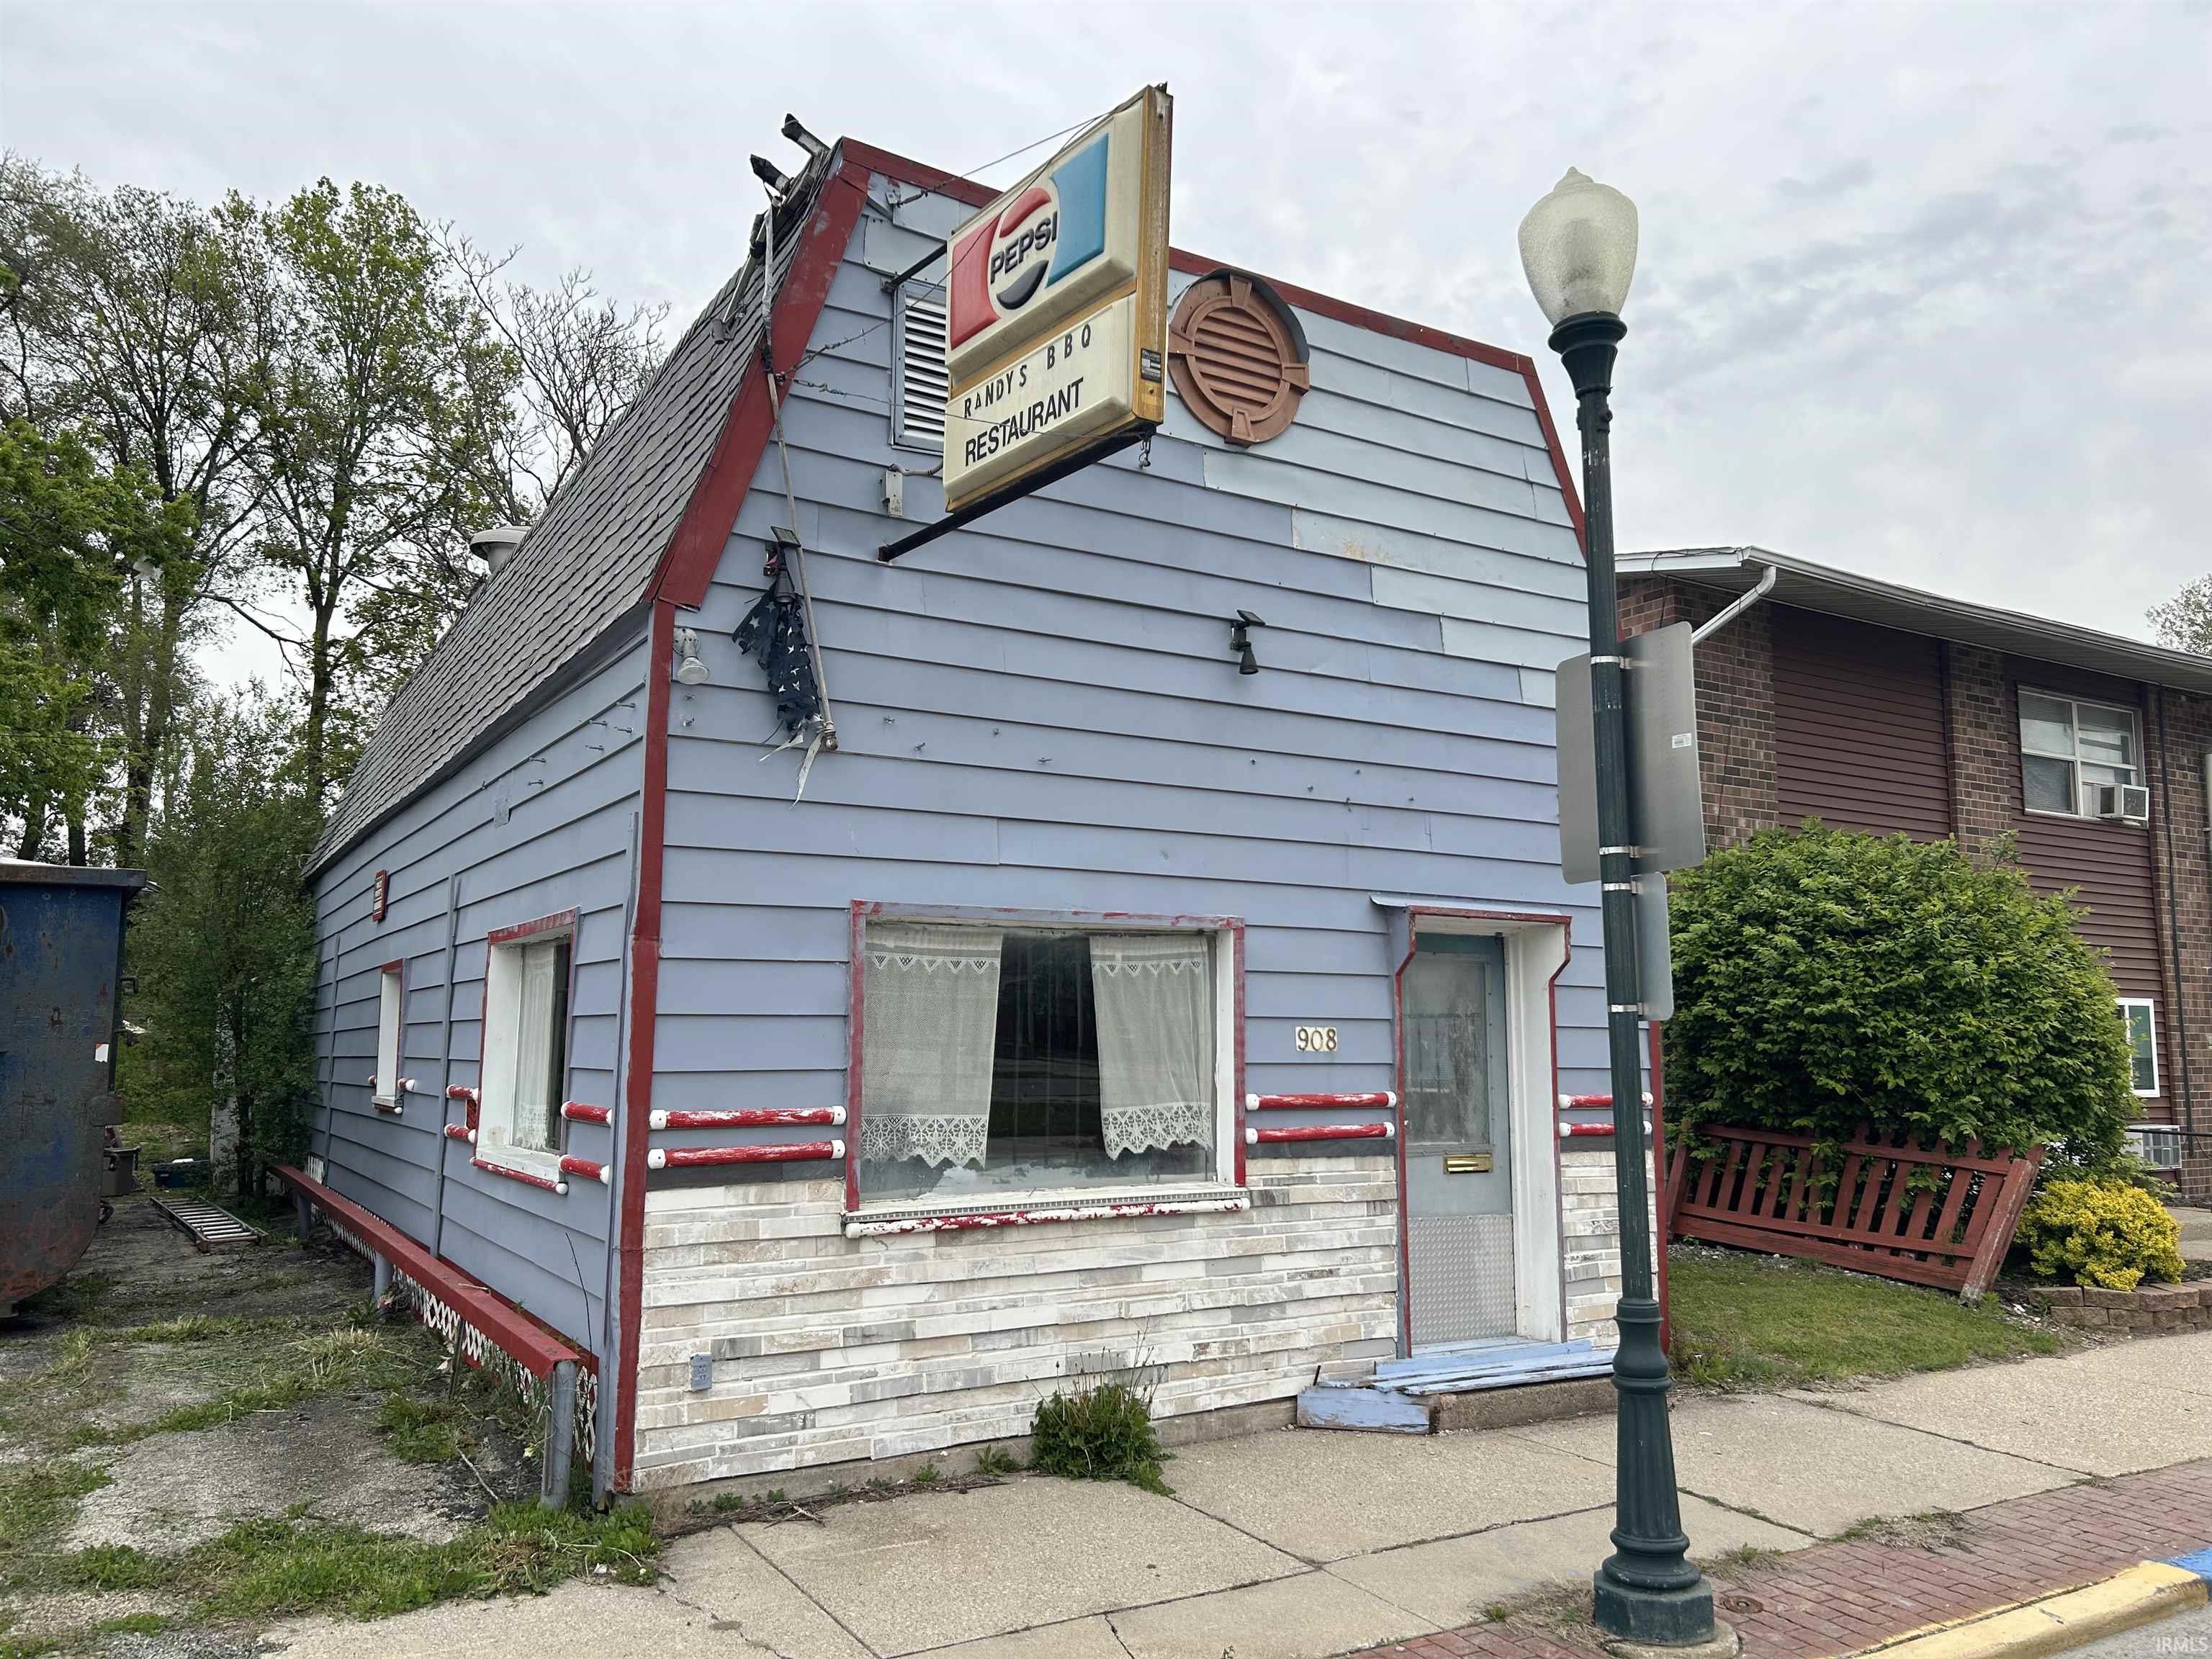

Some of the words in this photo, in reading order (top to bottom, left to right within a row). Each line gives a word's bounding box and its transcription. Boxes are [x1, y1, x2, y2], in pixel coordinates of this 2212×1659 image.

[990, 211, 1058, 285] PEPSI
[964, 364, 1028, 419] RANDYS
[965, 377, 1084, 467] RESTAURANT
[1298, 1028, 1337, 1051] 908
